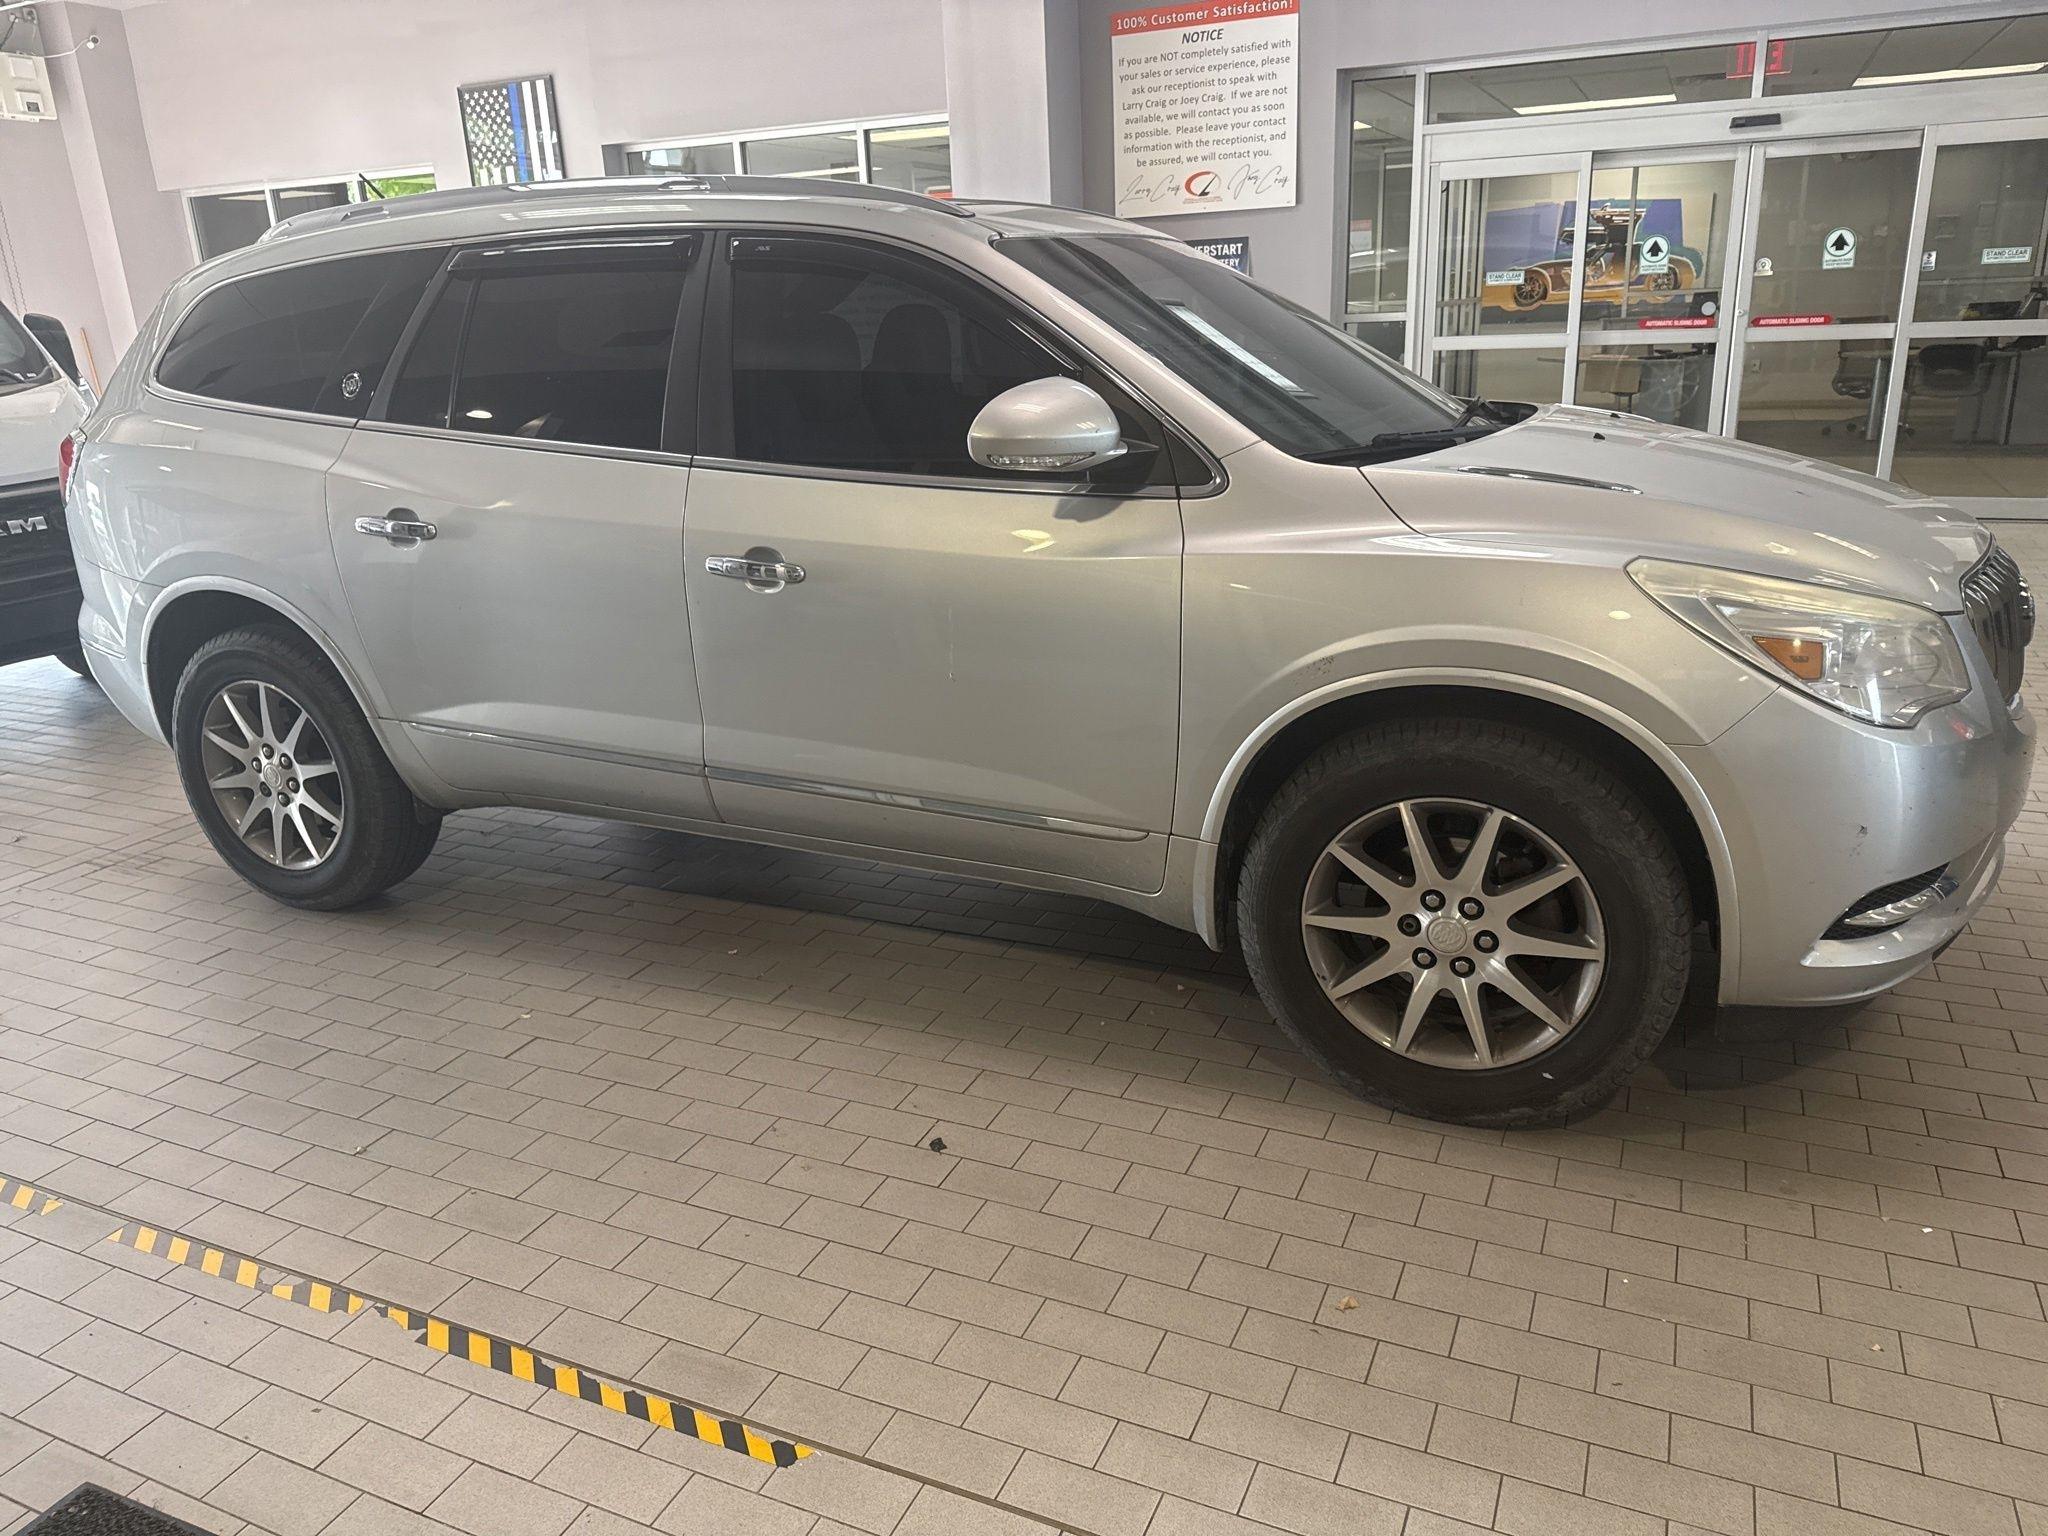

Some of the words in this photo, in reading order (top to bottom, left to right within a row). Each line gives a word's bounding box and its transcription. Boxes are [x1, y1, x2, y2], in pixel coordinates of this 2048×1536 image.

[1116, 15, 1148, 30] 100%
[1151, 10, 1209, 26] Customer
[1213, 0, 1293, 18] Satisfaction!
[1181, 28, 1224, 45] NOTICE
[1119, 57, 1125, 67] If
[1126, 58, 1142, 68] you
[1144, 55, 1158, 64] are
[1160, 51, 1179, 62] NOT
[1180, 45, 1229, 60] completely
[1231, 41, 1269, 54] satisfied
[1270, 38, 1292, 49] with
[1119, 73, 1138, 83] your
[1140, 69, 1161, 79] sales
[1163, 69, 1173, 77] or
[1174, 65, 1206, 76] service
[1207, 59, 1260, 73] experience,
[1261, 55, 1291, 69] please
[1131, 85, 1145, 95] ask
[1147, 85, 1162, 93] our
[1163, 78, 1215, 92] receptionist
[1217, 77, 1228, 86] to
[1229, 73, 1255, 86] speak
[1257, 70, 1278, 81] with
[1122, 102, 1143, 111] Larry
[1145, 99, 1167, 109] Craig
[1168, 98, 1178, 106] or
[1180, 95, 1200, 105] Joey
[1201, 91, 1226, 103] Craig.
[1231, 89, 1238, 100] If
[1239, 90, 1253, 99] we
[1255, 88, 1270, 97] are
[1272, 85, 1288, 95] not
[1125, 113, 1164, 125] available,
[1165, 113, 1179, 121] we
[1180, 109, 1196, 119] will
[1198, 106, 1231, 118] contact
[1232, 106, 1249, 116] you
[1251, 104, 1261, 113] as
[1263, 102, 1285, 111] soon
[1123, 131, 1133, 140] as
[1134, 126, 1172, 140] possible.
[1176, 124, 1204, 135] Please
[1205, 122, 1229, 132] leave
[1230, 119, 1251, 130] your
[1253, 116, 1287, 128] contact
[1123, 141, 1173, 154] information
[1174, 138, 1194, 150] with
[1195, 138, 1210, 149] the
[1212, 132, 1267, 146] receptionist,
[1269, 130, 1286, 142] and
[1136, 158, 1147, 168] be
[1149, 154, 1184, 167] assured,
[1186, 154, 1200, 163] we
[1200, 150, 1216, 162] will
[1217, 149, 1251, 161] contact
[1252, 148, 1273, 159] you.
[1194, 243, 1243, 256] ERSTART
[1986, 250, 2007, 258] STAND
[2007, 248, 2028, 256] CLEAR
